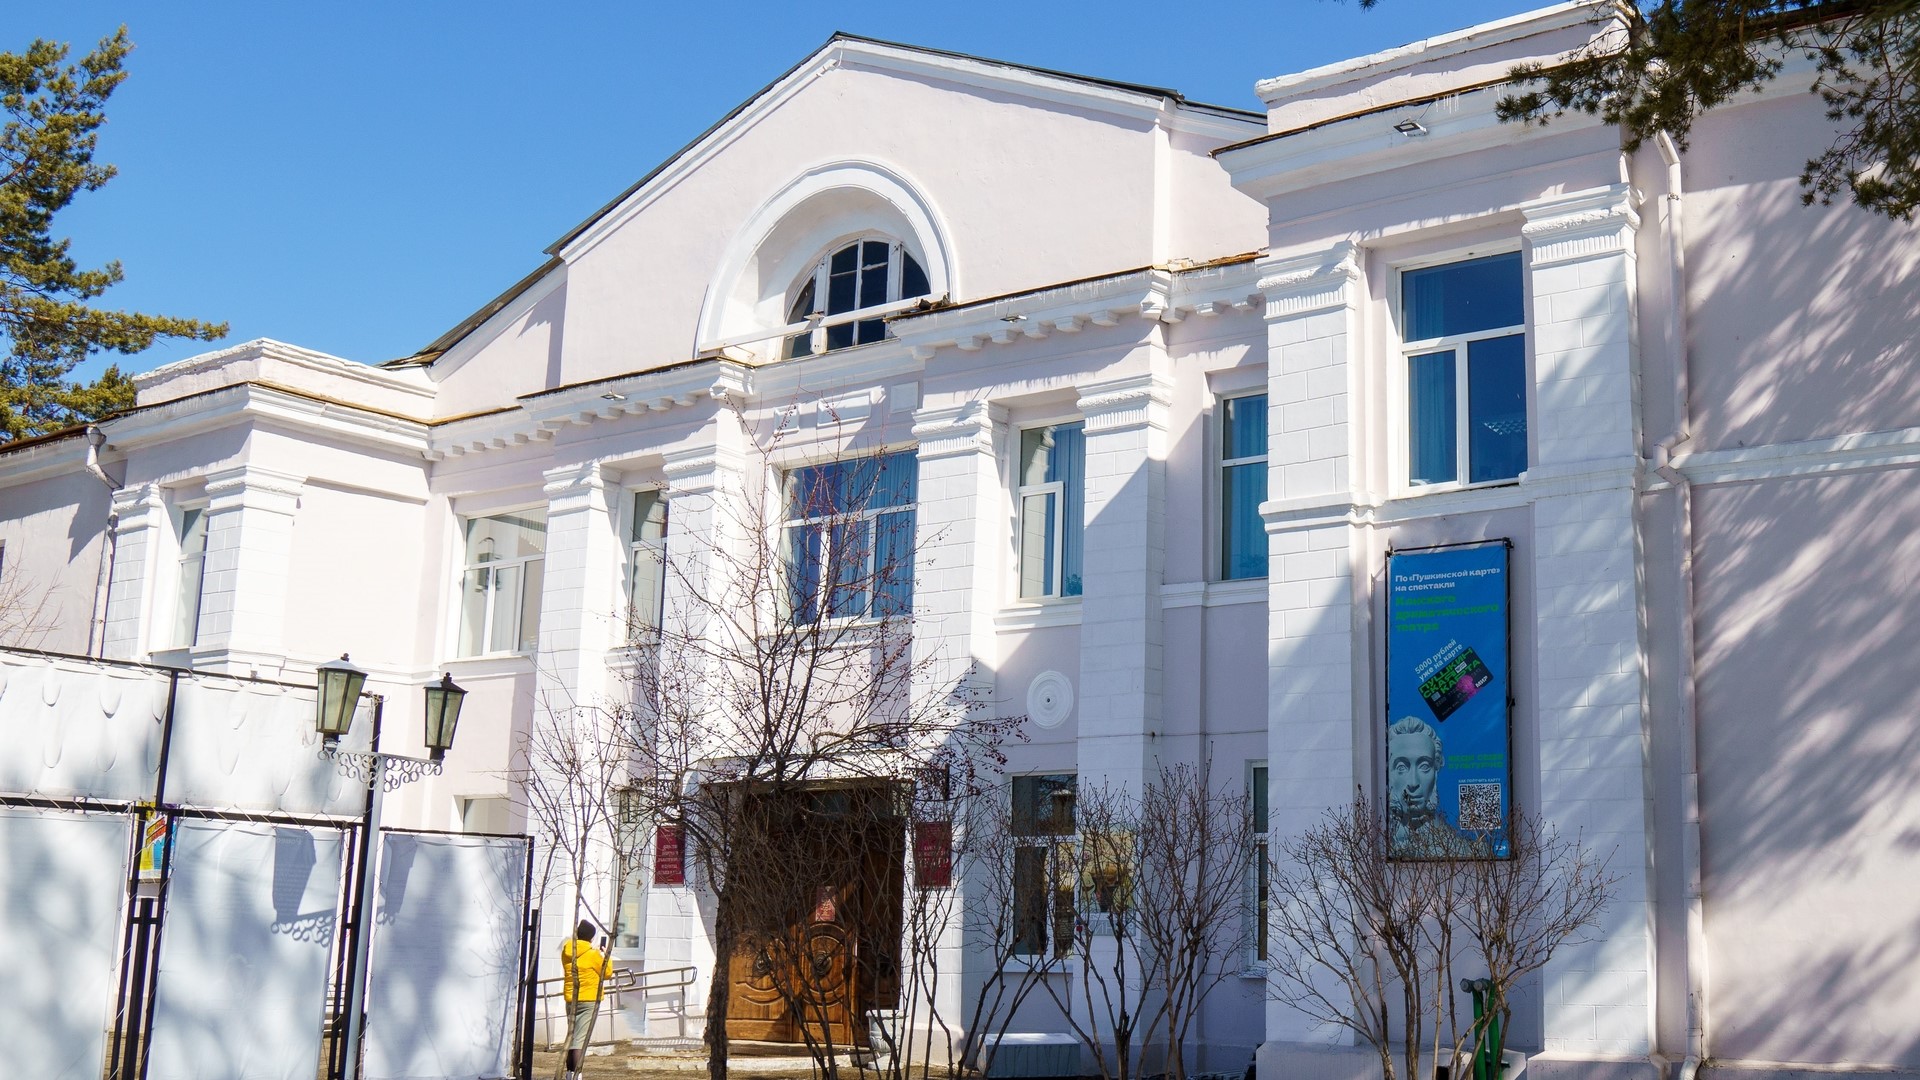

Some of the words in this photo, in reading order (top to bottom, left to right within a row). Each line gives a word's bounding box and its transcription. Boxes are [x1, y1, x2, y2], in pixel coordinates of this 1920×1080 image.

[1408, 581, 1456, 591] спектакли
[1409, 569, 1468, 582] «Пушкинской
[1469, 567, 1501, 578] карте»
[1414, 657, 1433, 674] 5000
[1432, 638, 1457, 663] рублей
[1418, 667, 1434, 682] уже
[1433, 660, 1444, 669] на
[1443, 644, 1463, 662] карте
[1440, 659, 1481, 694] КАРТА
